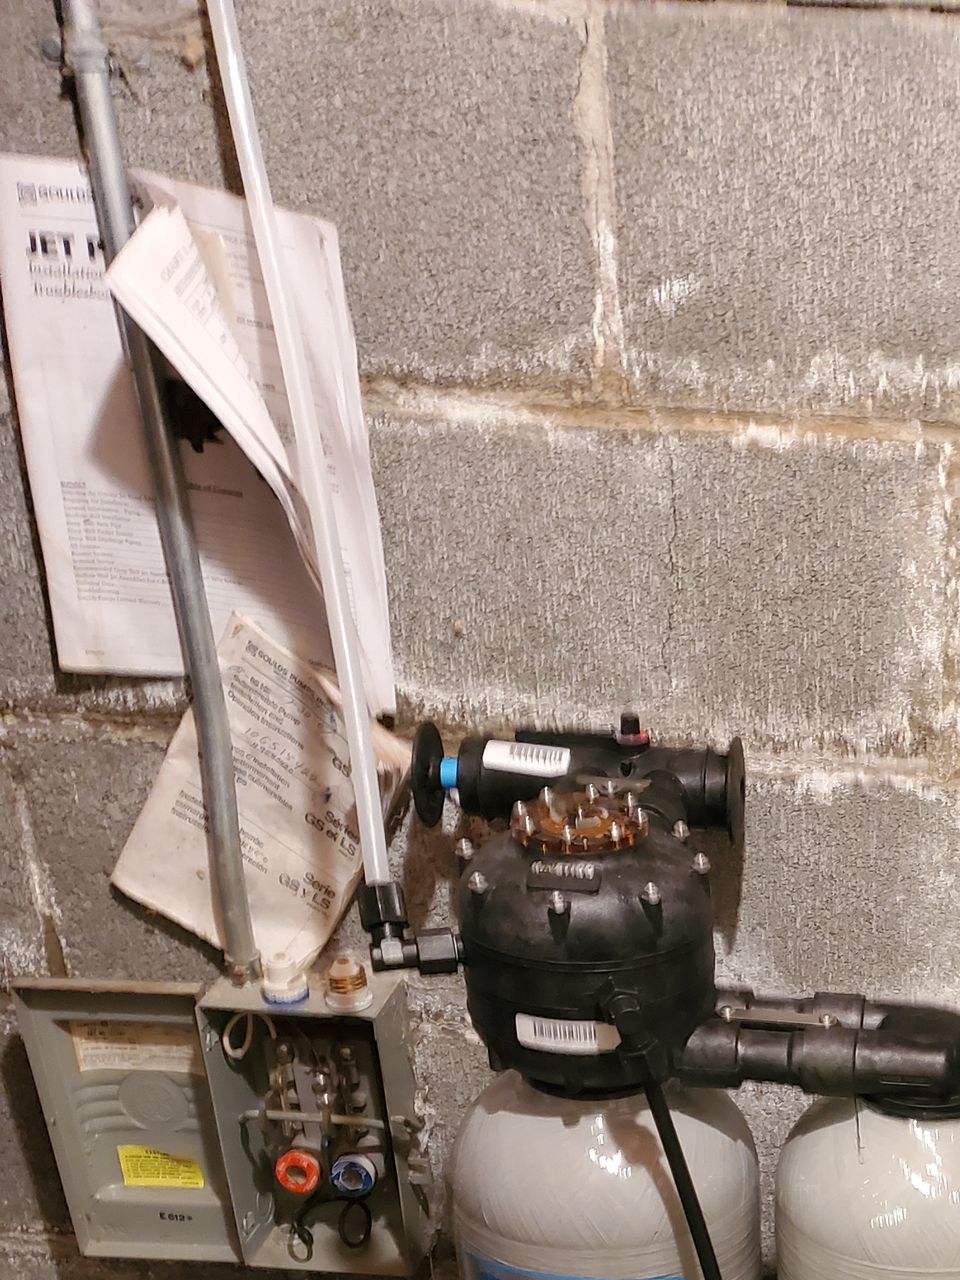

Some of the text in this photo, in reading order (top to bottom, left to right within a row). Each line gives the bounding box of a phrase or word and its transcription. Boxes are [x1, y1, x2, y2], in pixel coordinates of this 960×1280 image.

[26, 230, 75, 261] JET
[258, 650, 288, 676] GOULDS
[278, 706, 301, 727] Pump
[305, 812, 325, 833] GS
[340, 837, 357, 857] LS
[279, 872, 300, 893] GS
[312, 892, 331, 910] LS
[303, 871, 336, 899] Serie
